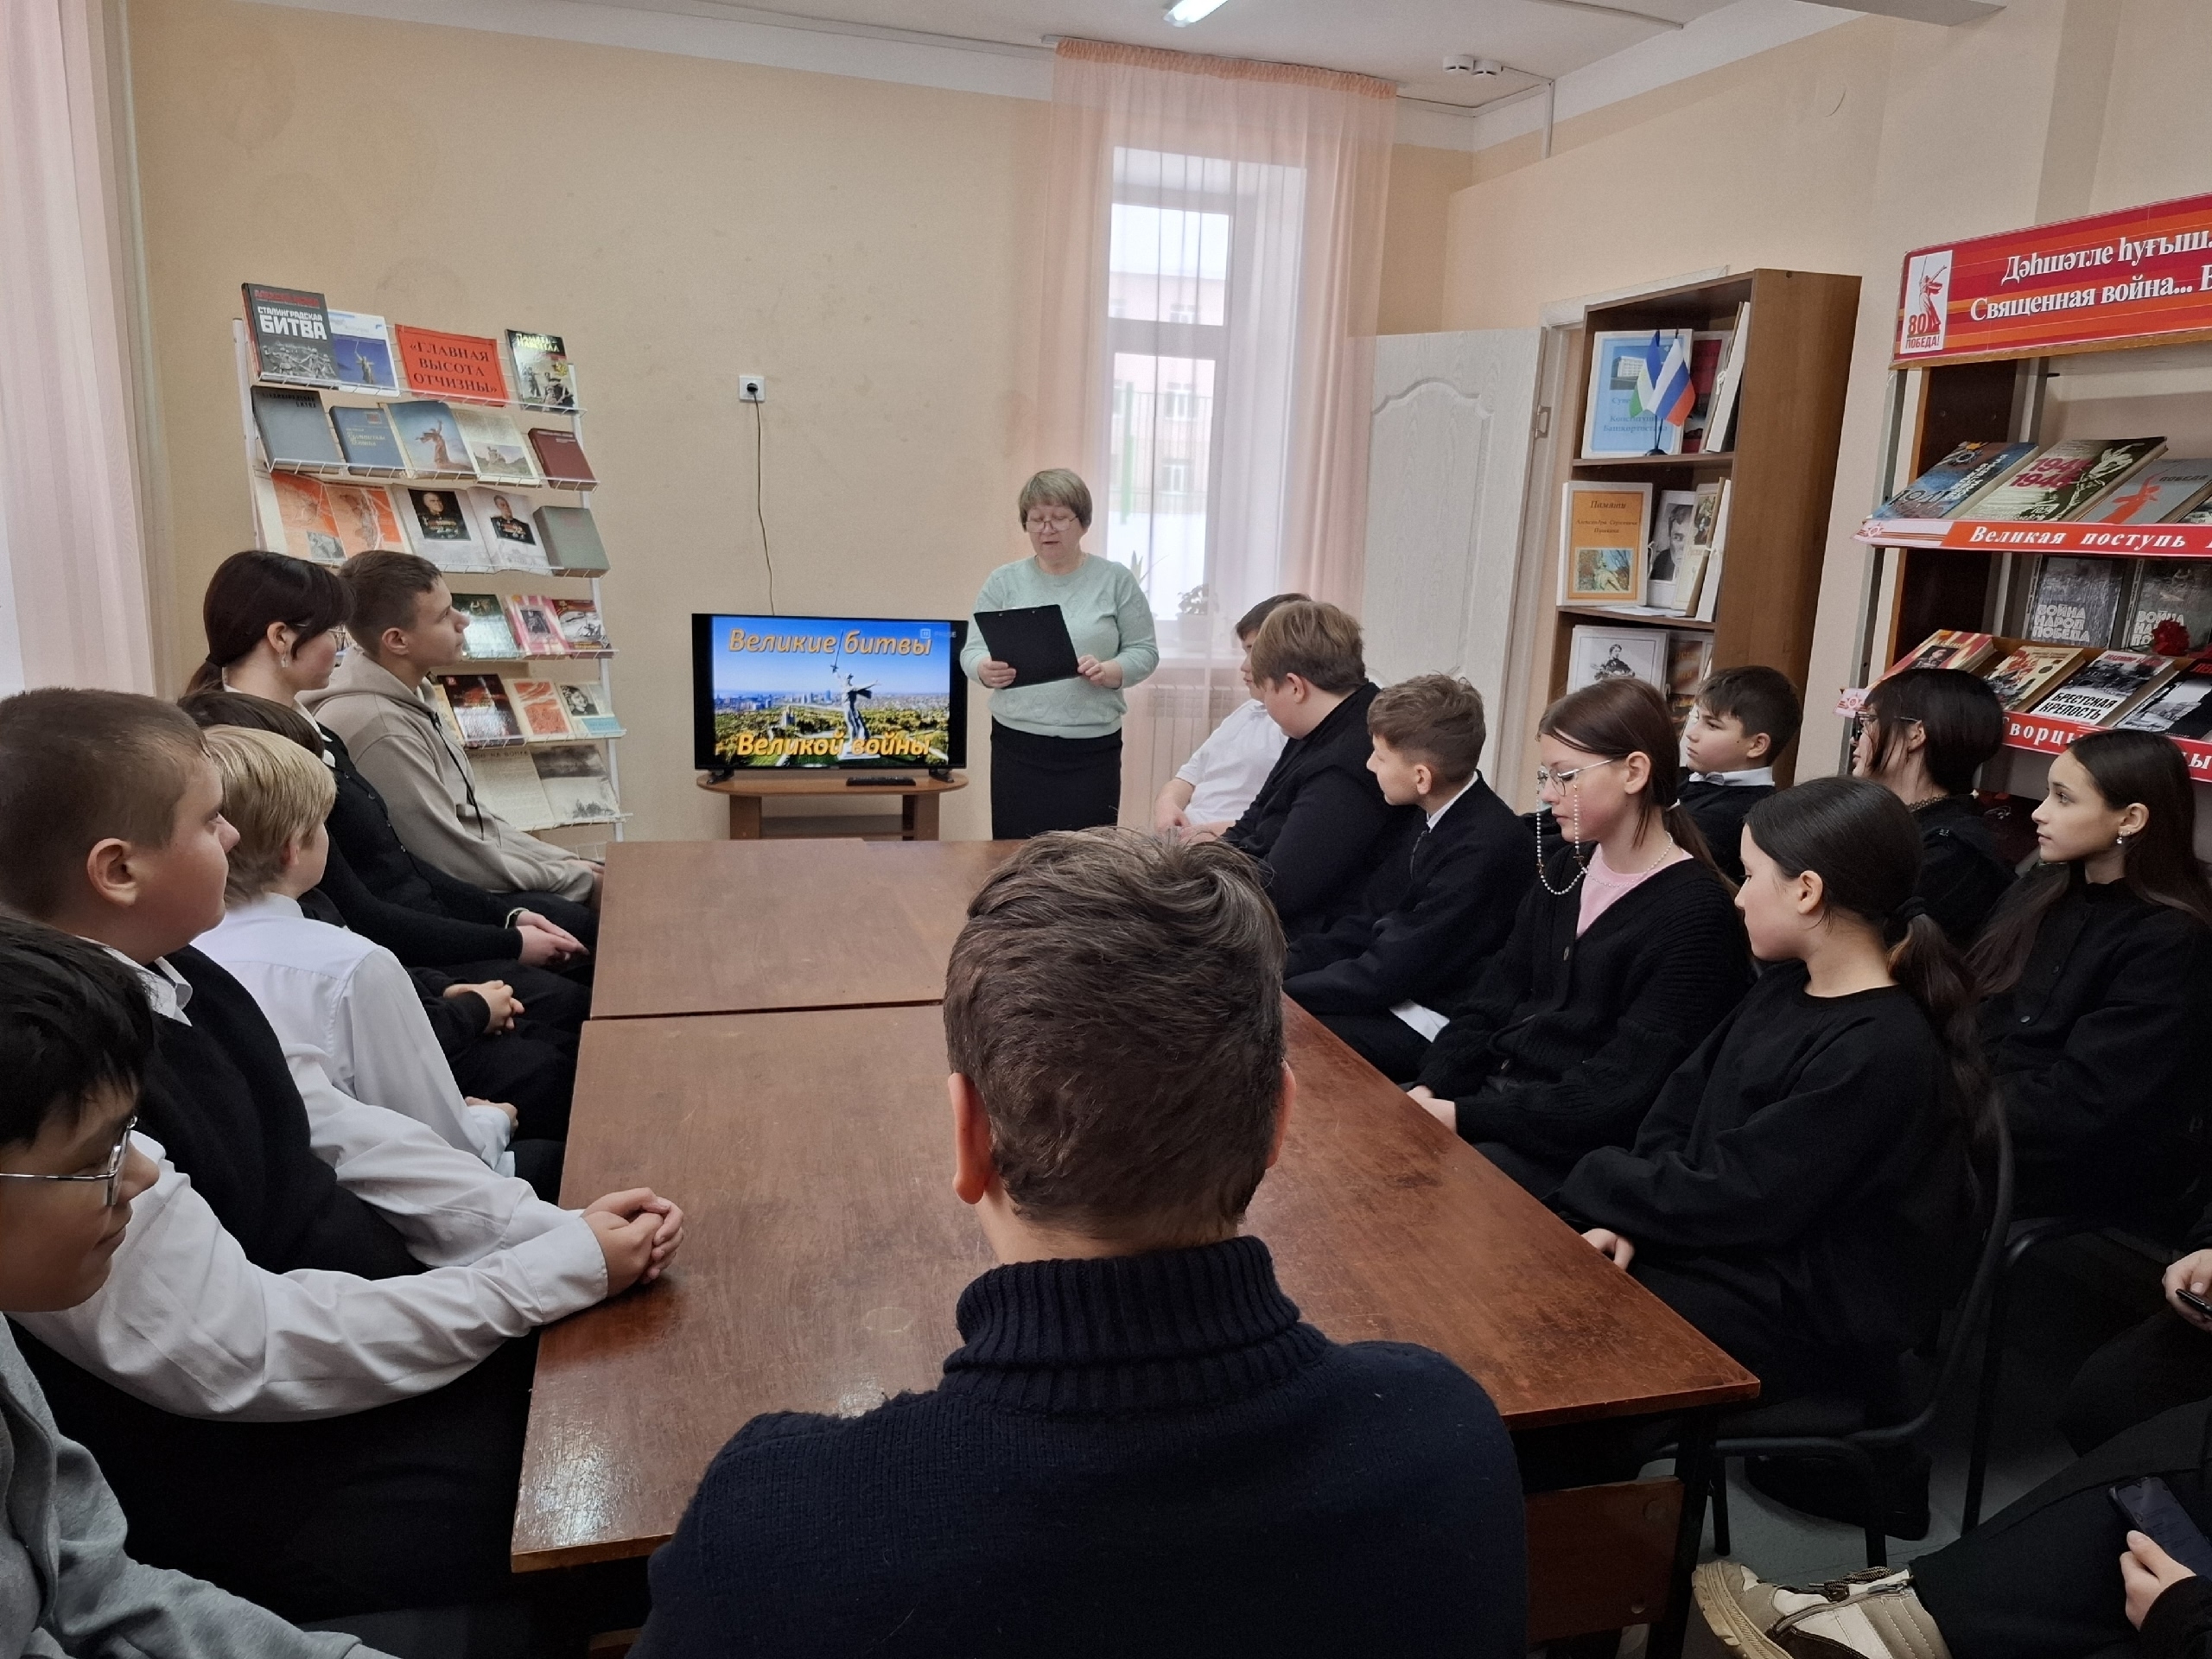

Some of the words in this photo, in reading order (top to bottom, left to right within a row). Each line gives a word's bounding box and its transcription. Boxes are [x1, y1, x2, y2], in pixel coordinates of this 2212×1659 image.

[2000, 245, 2114, 286] Дәһшәтле
[1970, 288, 2095, 321] Священная
[2100, 274, 2193, 304] война...
[257, 306, 323, 321] СТАЛИНГРАДСКАЯ
[259, 314, 327, 340] БИТВА
[1908, 313, 1929, 335] 80
[410, 341, 490, 362] «ГЛАВНАЯ
[1905, 335, 1940, 349] ПОБЕДА!
[419, 358, 485, 377] ВЫСОТА
[413, 372, 497, 393] ОТЧИЗНЫ»
[1590, 500, 1626, 509] Памяти
[1968, 525, 2067, 544] Великая
[2080, 532, 2186, 551] поступь
[2036, 603, 2086, 620] ВОЙНА
[2033, 614, 2086, 631] НАРОД
[728, 627, 836, 653] Великие
[843, 630, 932, 655] битвы
[2031, 626, 2090, 642] ПОБЕДА
[2050, 692, 2118, 709] БРЕСТСКАЯ
[2038, 702, 2101, 720] КРЕПОСТЬ
[736, 732, 846, 756] Великой
[851, 731, 932, 756] войны
